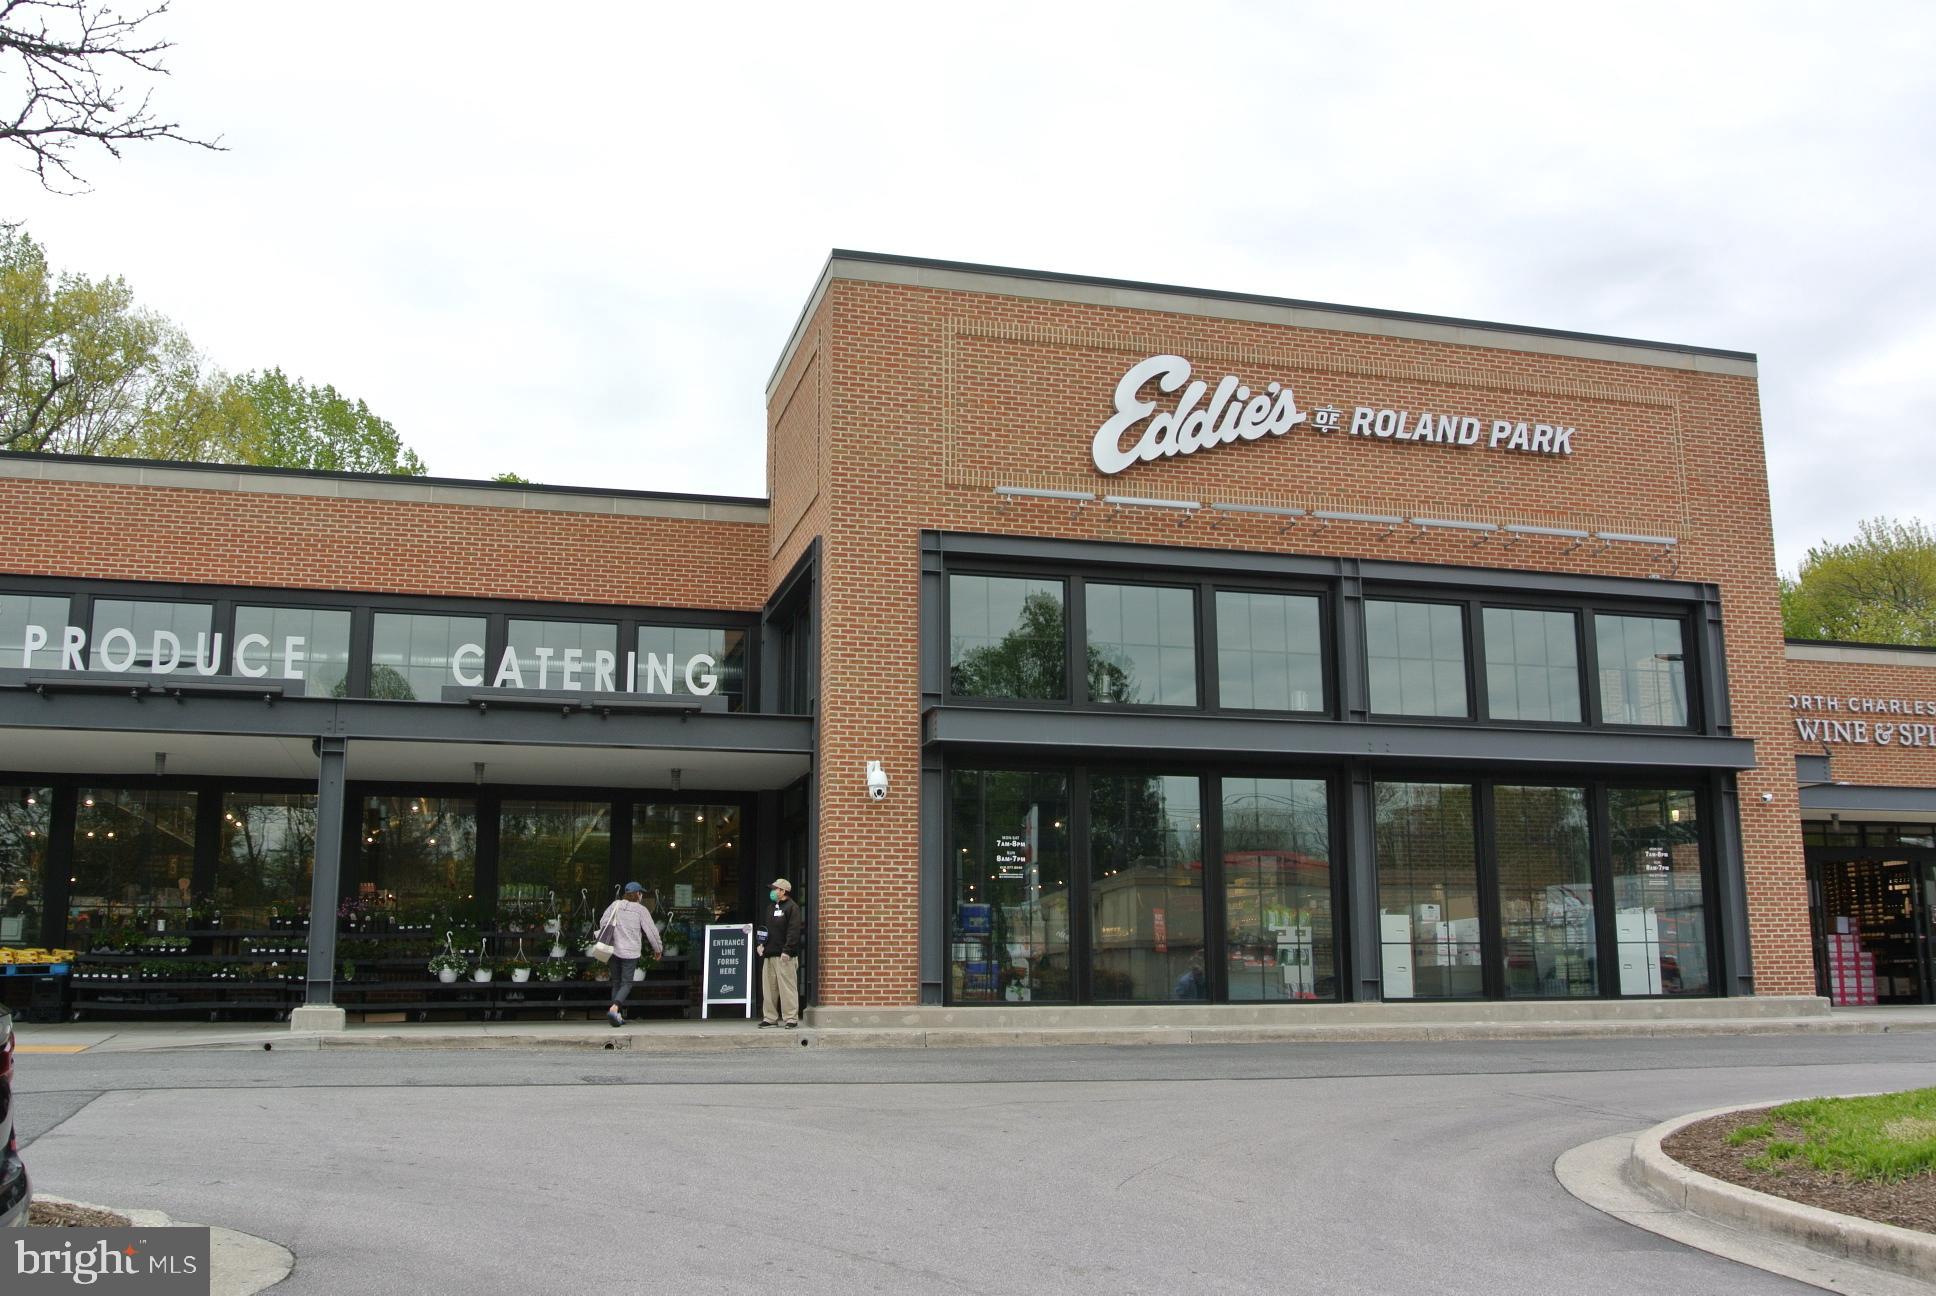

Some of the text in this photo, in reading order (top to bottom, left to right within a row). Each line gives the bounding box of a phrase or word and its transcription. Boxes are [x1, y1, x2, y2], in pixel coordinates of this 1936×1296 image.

[1092, 354, 1576, 475] Eddie's OF ROLAND PARK
[23, 625, 306, 680] PRODUCE
[452, 643, 718, 696] CATERING
[1848, 697, 1936, 715] CHARLES
[1795, 718, 1869, 744] WINE
[1874, 722, 1894, 746] &
[712, 939, 745, 947] ENTRANCE
[721, 948, 736, 956] LINE
[717, 958, 740, 966] FORMS
[719, 967, 737, 975] HERE
